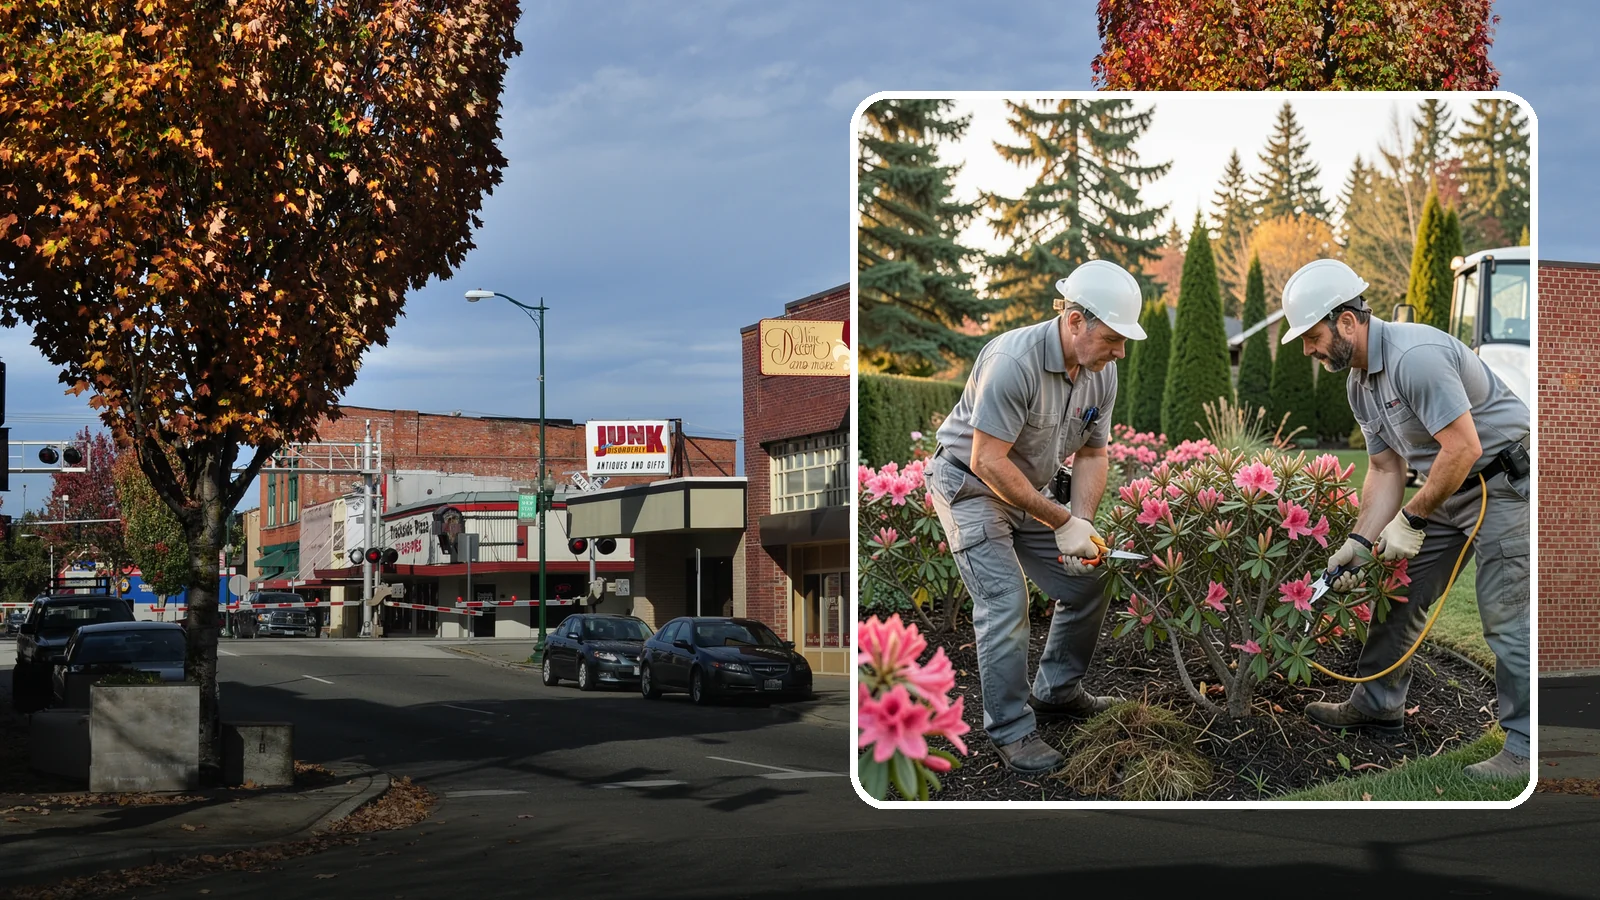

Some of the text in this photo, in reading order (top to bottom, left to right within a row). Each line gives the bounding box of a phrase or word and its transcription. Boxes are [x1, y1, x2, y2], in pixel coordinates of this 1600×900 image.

[595, 425, 665, 457] JUNK
[607, 446, 646, 454] DISORDERLY
[596, 460, 665, 470] ANTIQUES AND GIFTS
